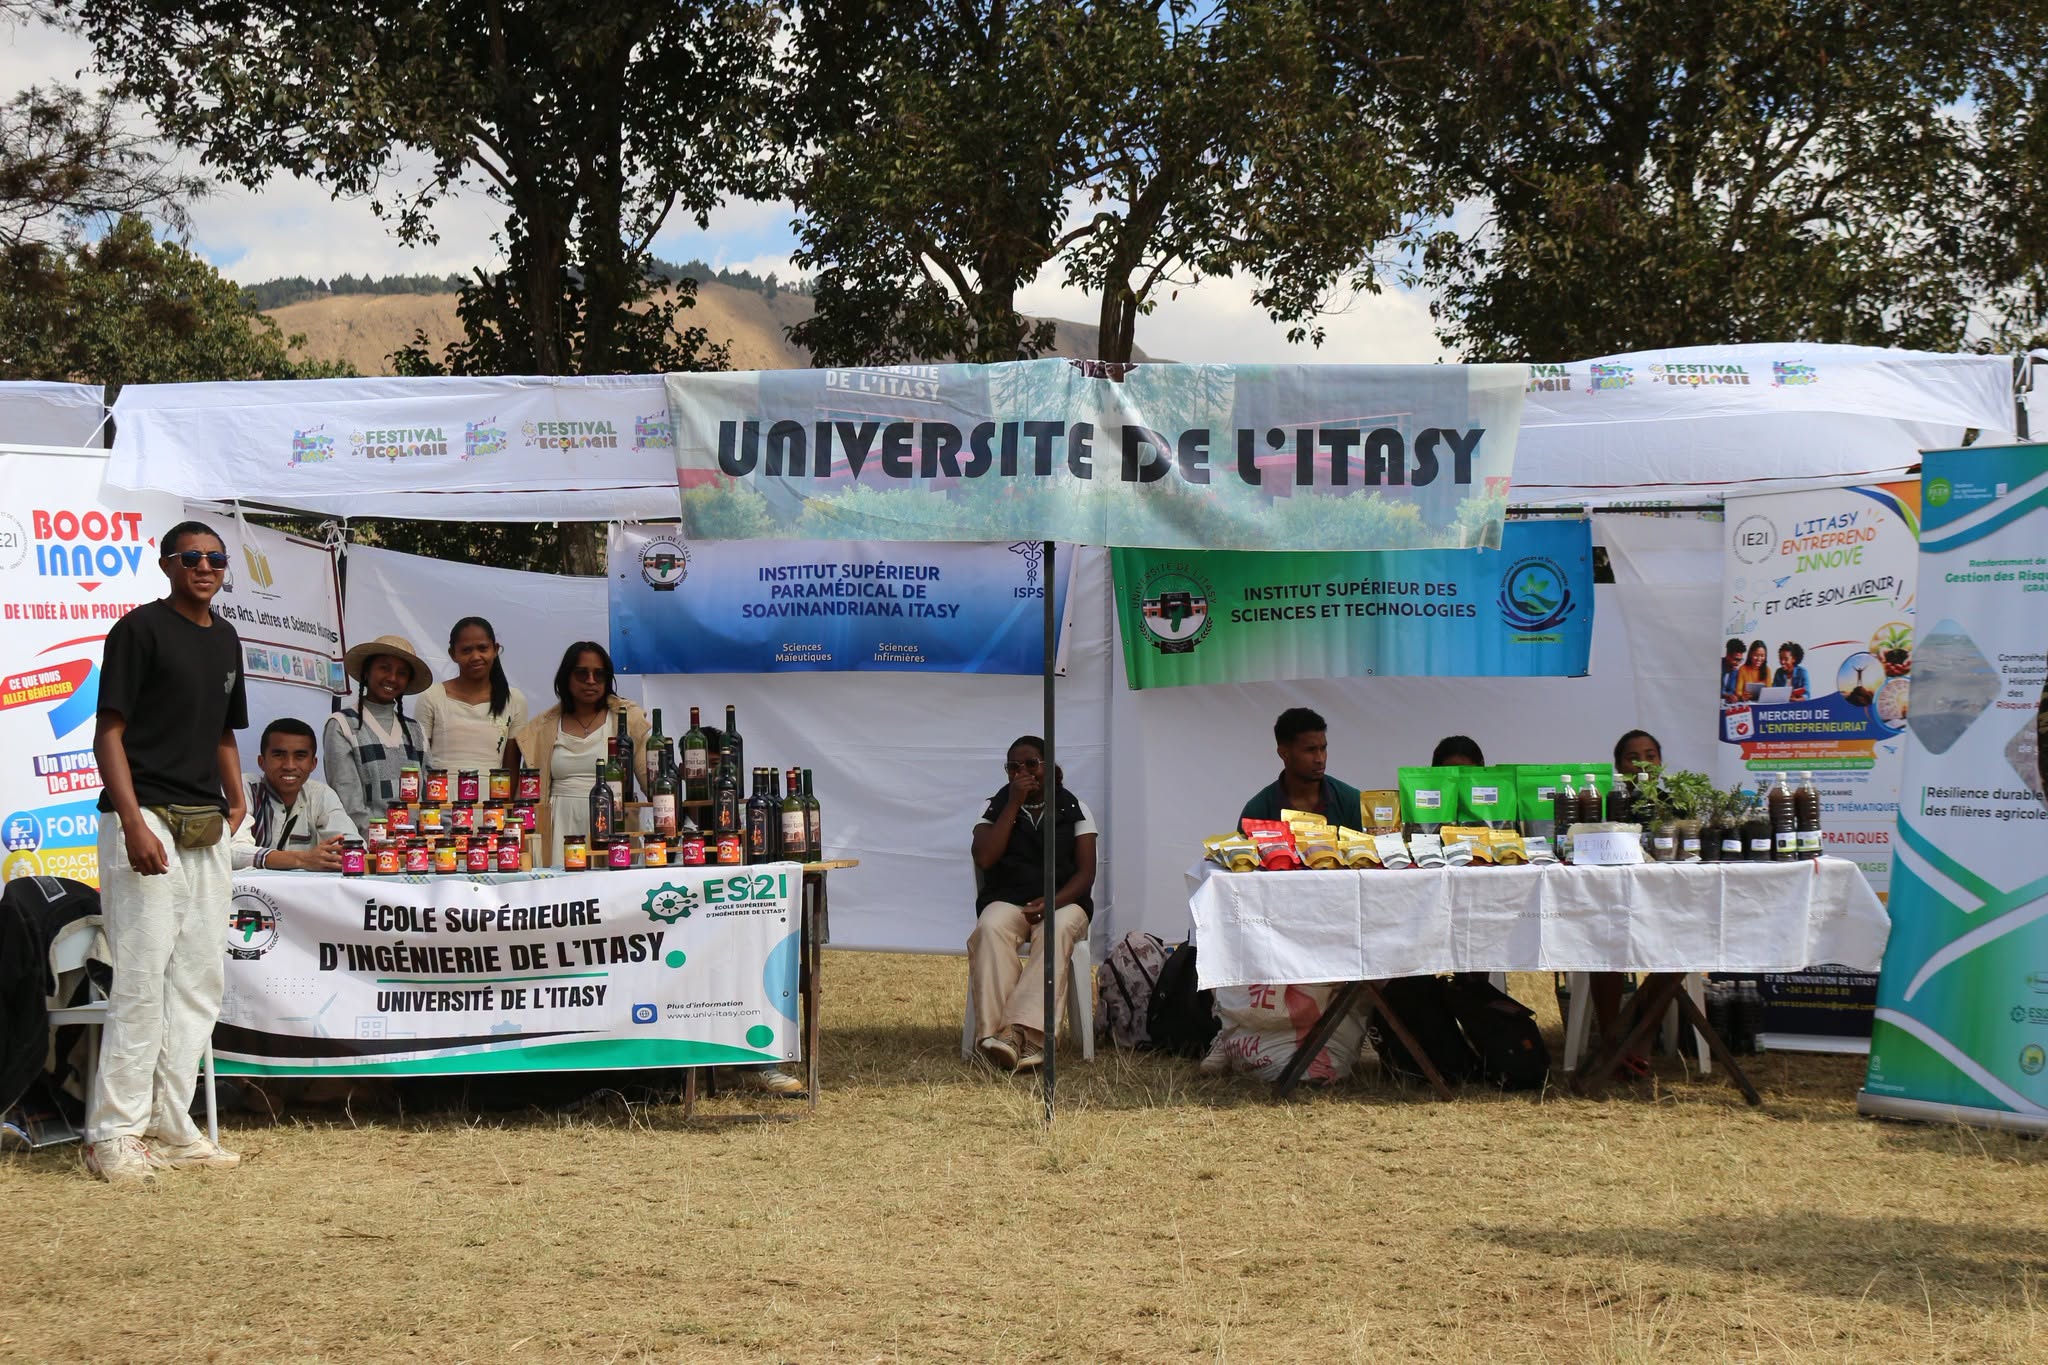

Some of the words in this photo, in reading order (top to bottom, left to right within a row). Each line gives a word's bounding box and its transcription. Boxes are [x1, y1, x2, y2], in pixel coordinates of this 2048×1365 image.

[1665, 364, 1749, 375] FESTIVAL
[826, 370, 851, 388] DE
[860, 375, 939, 400] L'ITASY
[366, 428, 447, 445] FESTIVAL
[538, 421, 617, 436] FESTIVAL
[718, 420, 1094, 480] UNIVERSITE
[1121, 425, 1210, 484] DE
[1238, 428, 1485, 486] L'ITASY
[32, 510, 142, 541] BOOST
[1795, 511, 1858, 537] L'ITASY
[1781, 528, 1876, 555] ENTREPREND
[36, 544, 143, 577] INNOV
[1177, 563, 1190, 572] DE
[1795, 546, 1863, 573] INNOVE
[1969, 558, 2033, 567] Renforcement
[759, 564, 837, 581] INSTITUT
[842, 561, 940, 581] SUPÉRIEUR
[1945, 572, 1991, 583] Gestion
[1994, 571, 2015, 582] des
[771, 577, 897, 599] PARAMÉDICAL
[903, 584, 926, 599] DE
[1014, 587, 1044, 599] ISPS
[1244, 584, 1321, 600] INSTITUT
[1326, 578, 1419, 597] SUPÉRIEUR
[1425, 583, 1457, 596] DES
[1765, 600, 1781, 615] ET
[1785, 588, 1813, 610] CRÉE
[1816, 588, 1844, 603] SON
[1849, 576, 1894, 597] AVENIR
[4, 604, 19, 619] DE
[23, 601, 57, 619] L'IDÉE
[60, 600, 68, 619] À
[71, 604, 88, 619] UN
[742, 602, 903, 618] SOAVINANDRIANA
[908, 604, 960, 618] ITASY
[1231, 605, 1316, 622] SCIENCES
[1321, 604, 1338, 618] ET
[1345, 602, 1476, 618] TECHNOLOGIES
[222, 602, 236, 619] des
[256, 609, 282, 628] Lettres
[282, 616, 291, 630] et
[291, 615, 317, 635] Sciences
[783, 643, 821, 652] Sciences
[879, 642, 918, 652] Sciences
[775, 653, 832, 663] Maïeutiques
[874, 653, 925, 663] Infirmières
[9, 675, 21, 690] CE
[22, 673, 39, 688] QUE
[39, 670, 61, 684] VOUS
[3, 690, 27, 705] ALLEZ
[28, 681, 73, 700] BÉNÉFICIER
[2008, 690, 2024, 698] des
[1996, 701, 2032, 710] Risques
[1759, 710, 1812, 721] MERCREDI
[1815, 709, 1830, 720] DE
[1759, 721, 1868, 734] L'ENTREPRENEURIAT
[38, 755, 58, 774] Un
[51, 775, 68, 792] De
[1927, 787, 1989, 798] Résilience
[1993, 788, 2043, 800] durable
[1837, 801, 1899, 812] THÉMATIQUES
[1925, 806, 1946, 816] des
[1950, 806, 1991, 817] filières
[1822, 831, 1889, 844] PRATIQUES
[47, 853, 96, 869] COACH
[251, 886, 261, 895] DE
[263, 894, 282, 922] L'ITASY
[364, 899, 437, 932] ÉCOLE
[445, 898, 601, 932] SUPÉRIEURE
[706, 910, 750, 918] D'INGÉNIERIE
[319, 940, 501, 973] D'INGÉNIERIE
[510, 941, 548, 971] DE
[557, 931, 665, 968] L'ITASY
[1764, 974, 1774, 983] ET
[1775, 975, 1785, 983] DE
[1787, 975, 1837, 985] L'INNOVATION
[1839, 977, 1848, 985] DE
[1850, 977, 1877, 986] L'ITASY
[377, 986, 493, 1013] UNIVERSITÉ
[501, 988, 526, 1010] DE
[533, 985, 607, 1009] L'ITASY
[667, 1002, 685, 1010] Plus
[687, 999, 743, 1009] d'information
[667, 1008, 761, 1020] www.univ-itasy.com
